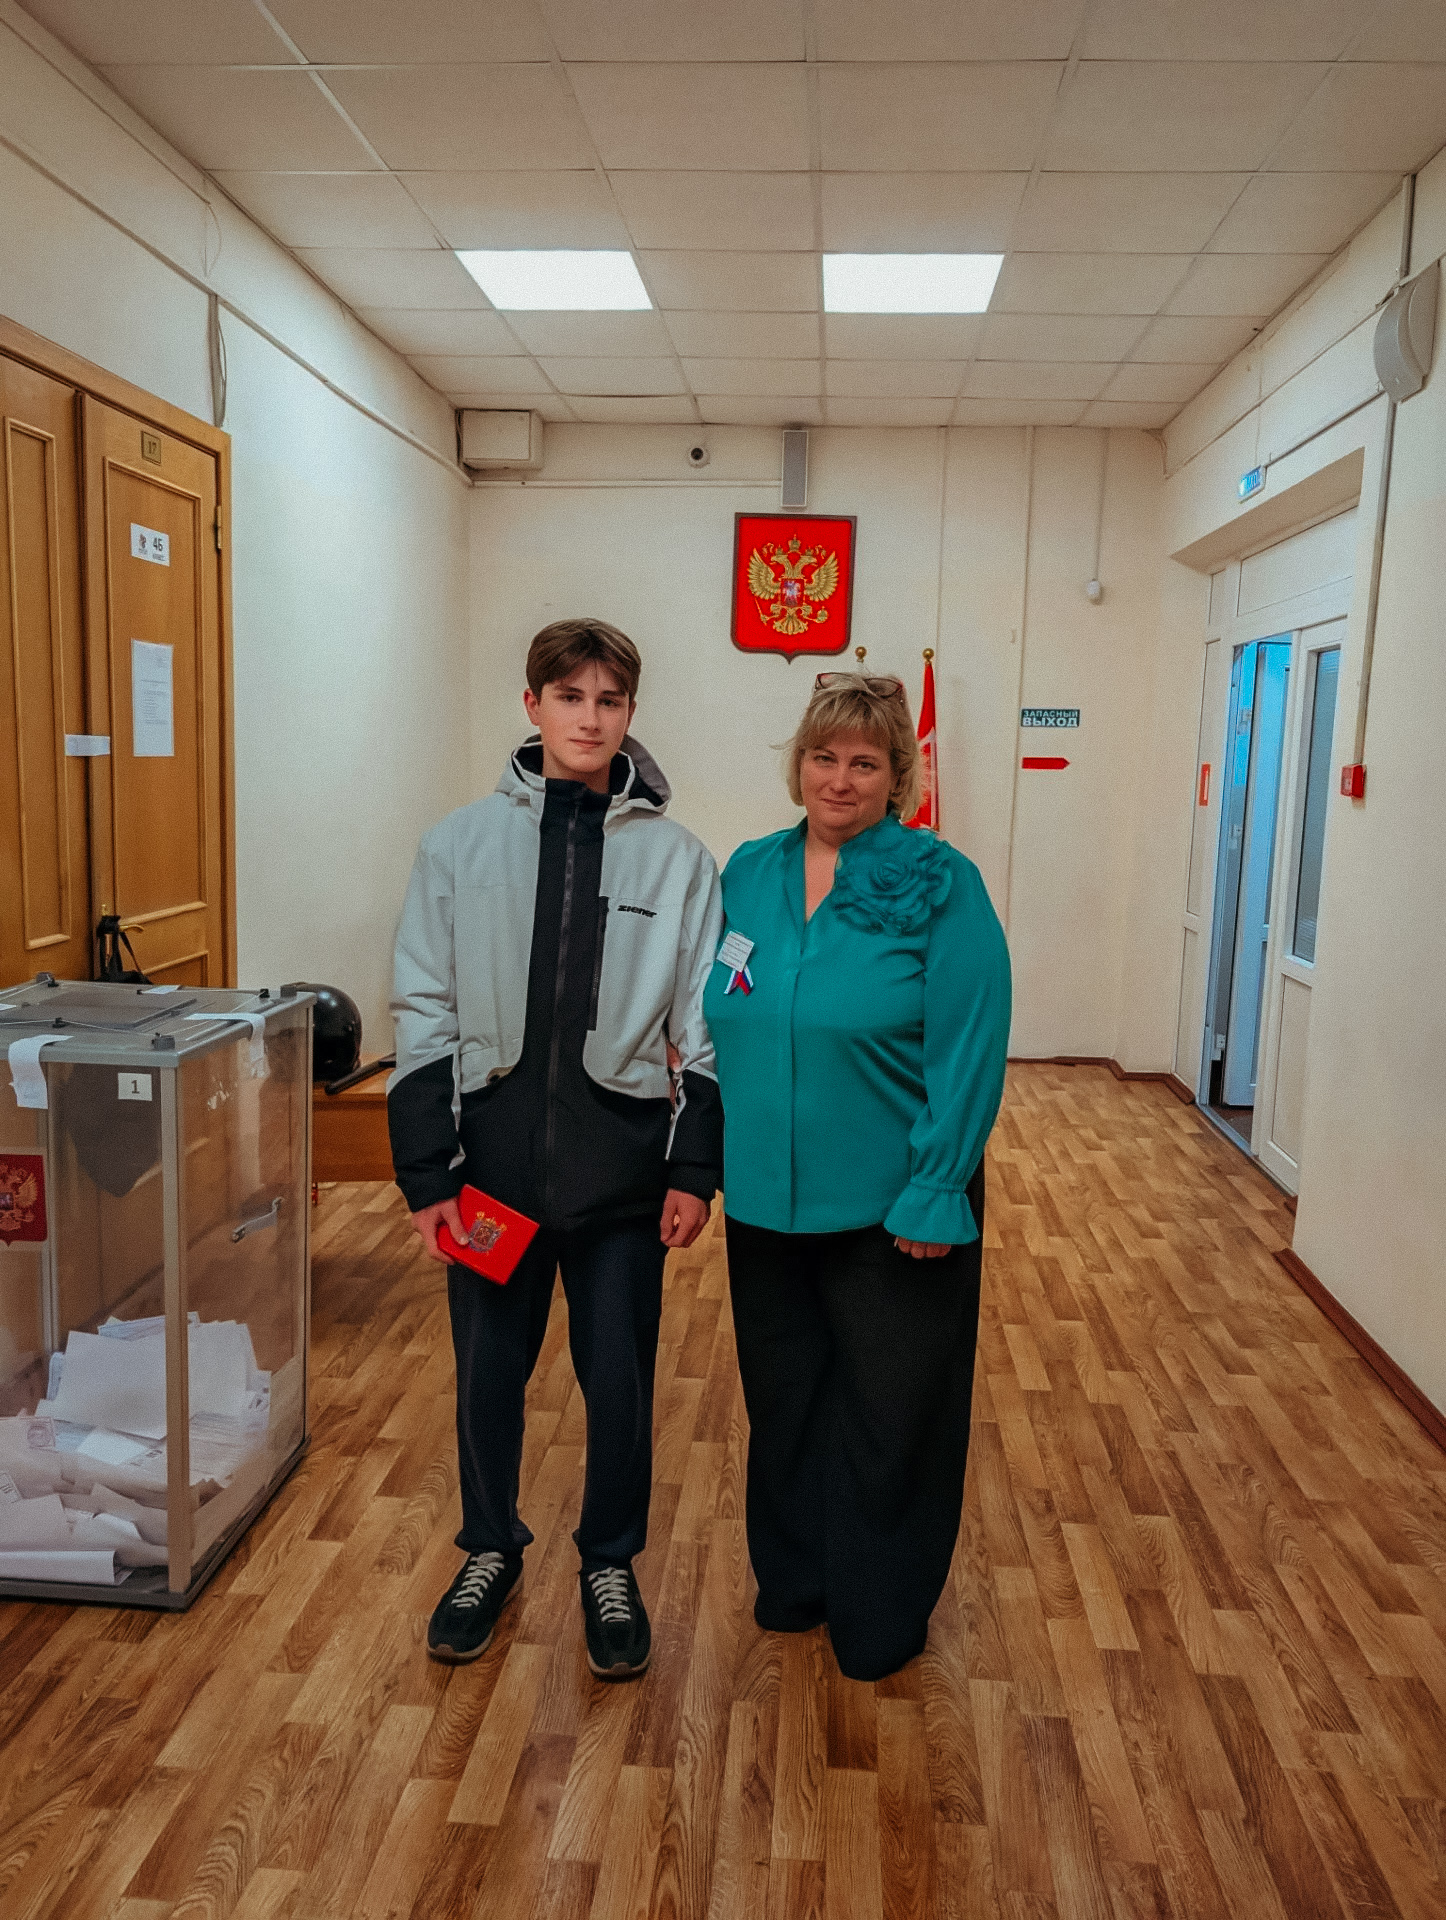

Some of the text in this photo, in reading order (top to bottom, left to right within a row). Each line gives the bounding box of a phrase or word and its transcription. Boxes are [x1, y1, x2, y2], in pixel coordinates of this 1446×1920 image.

[1023, 710, 1078, 718] ЗАПАСНЫЙ
[1022, 717, 1078, 727] ВЫХОД
[131, 1080, 140, 1094] 1
